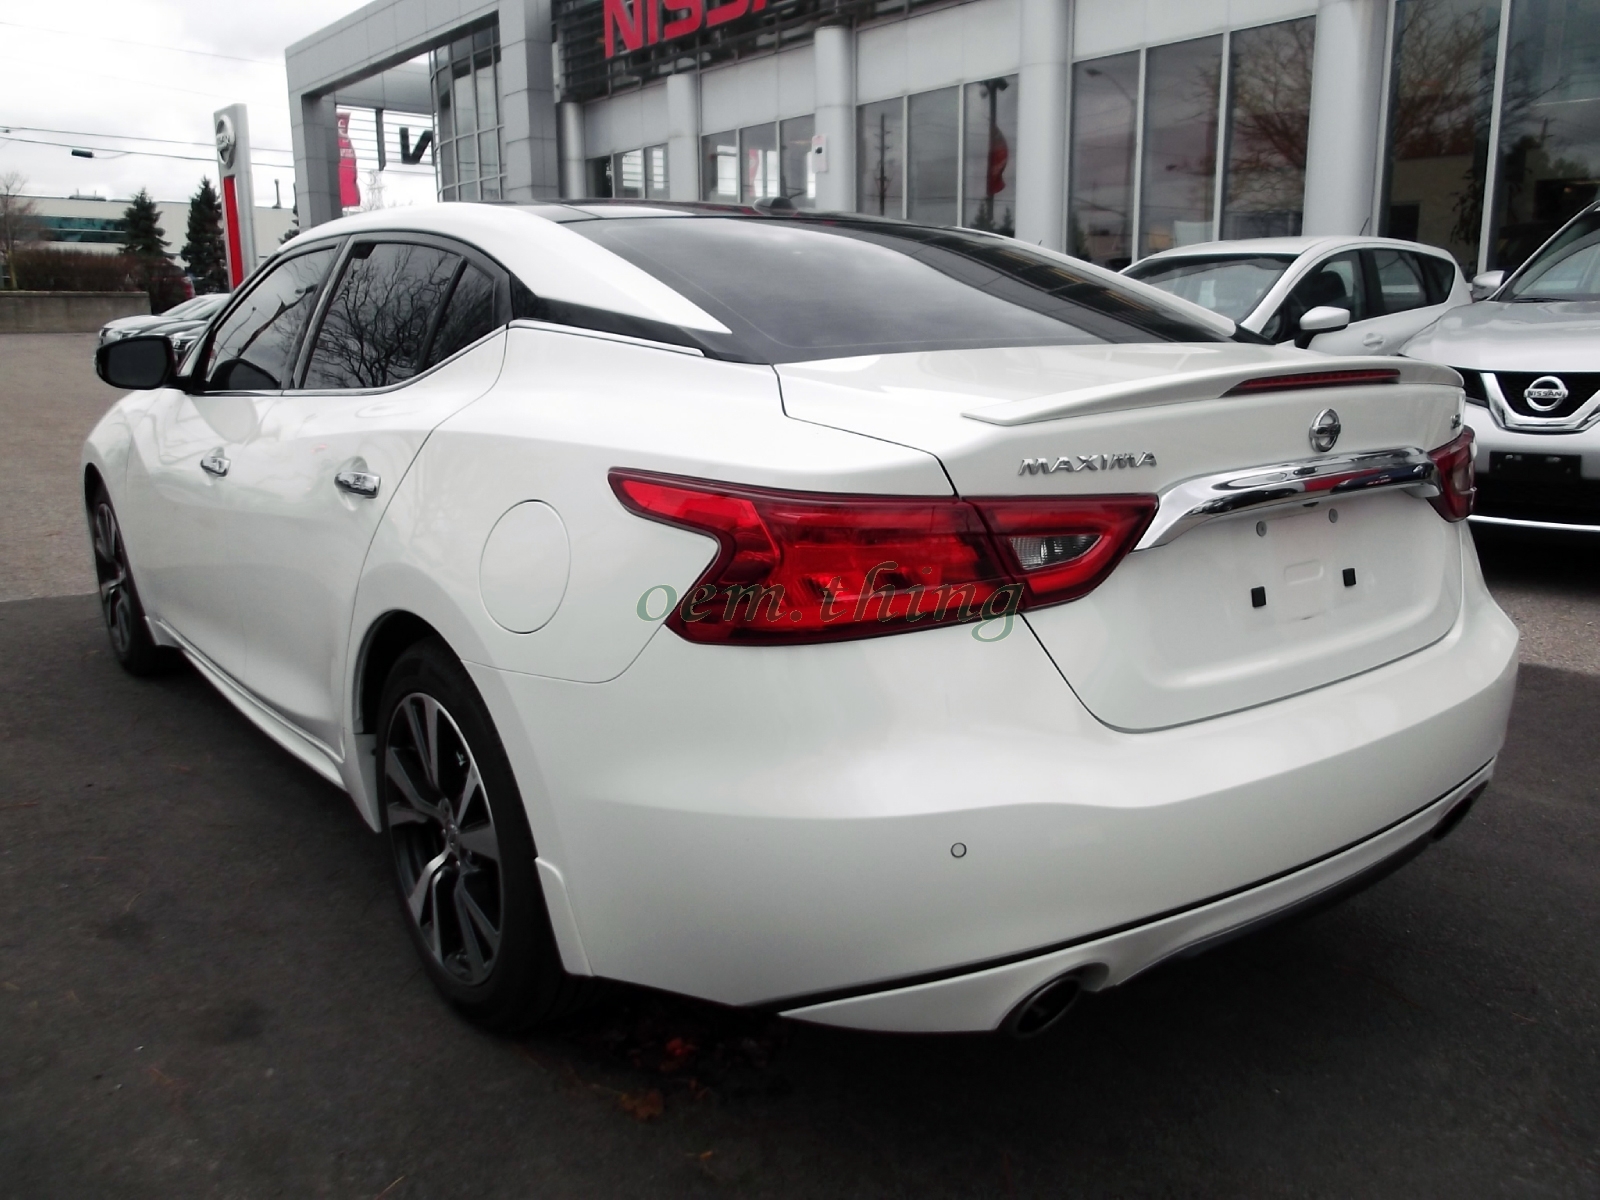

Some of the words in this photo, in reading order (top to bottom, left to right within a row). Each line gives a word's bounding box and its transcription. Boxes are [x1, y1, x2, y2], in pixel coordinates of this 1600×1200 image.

[604, 0, 767, 59] NIS
[1527, 389, 1563, 398] NISSAN
[1018, 451, 1157, 475] MAXIMA
